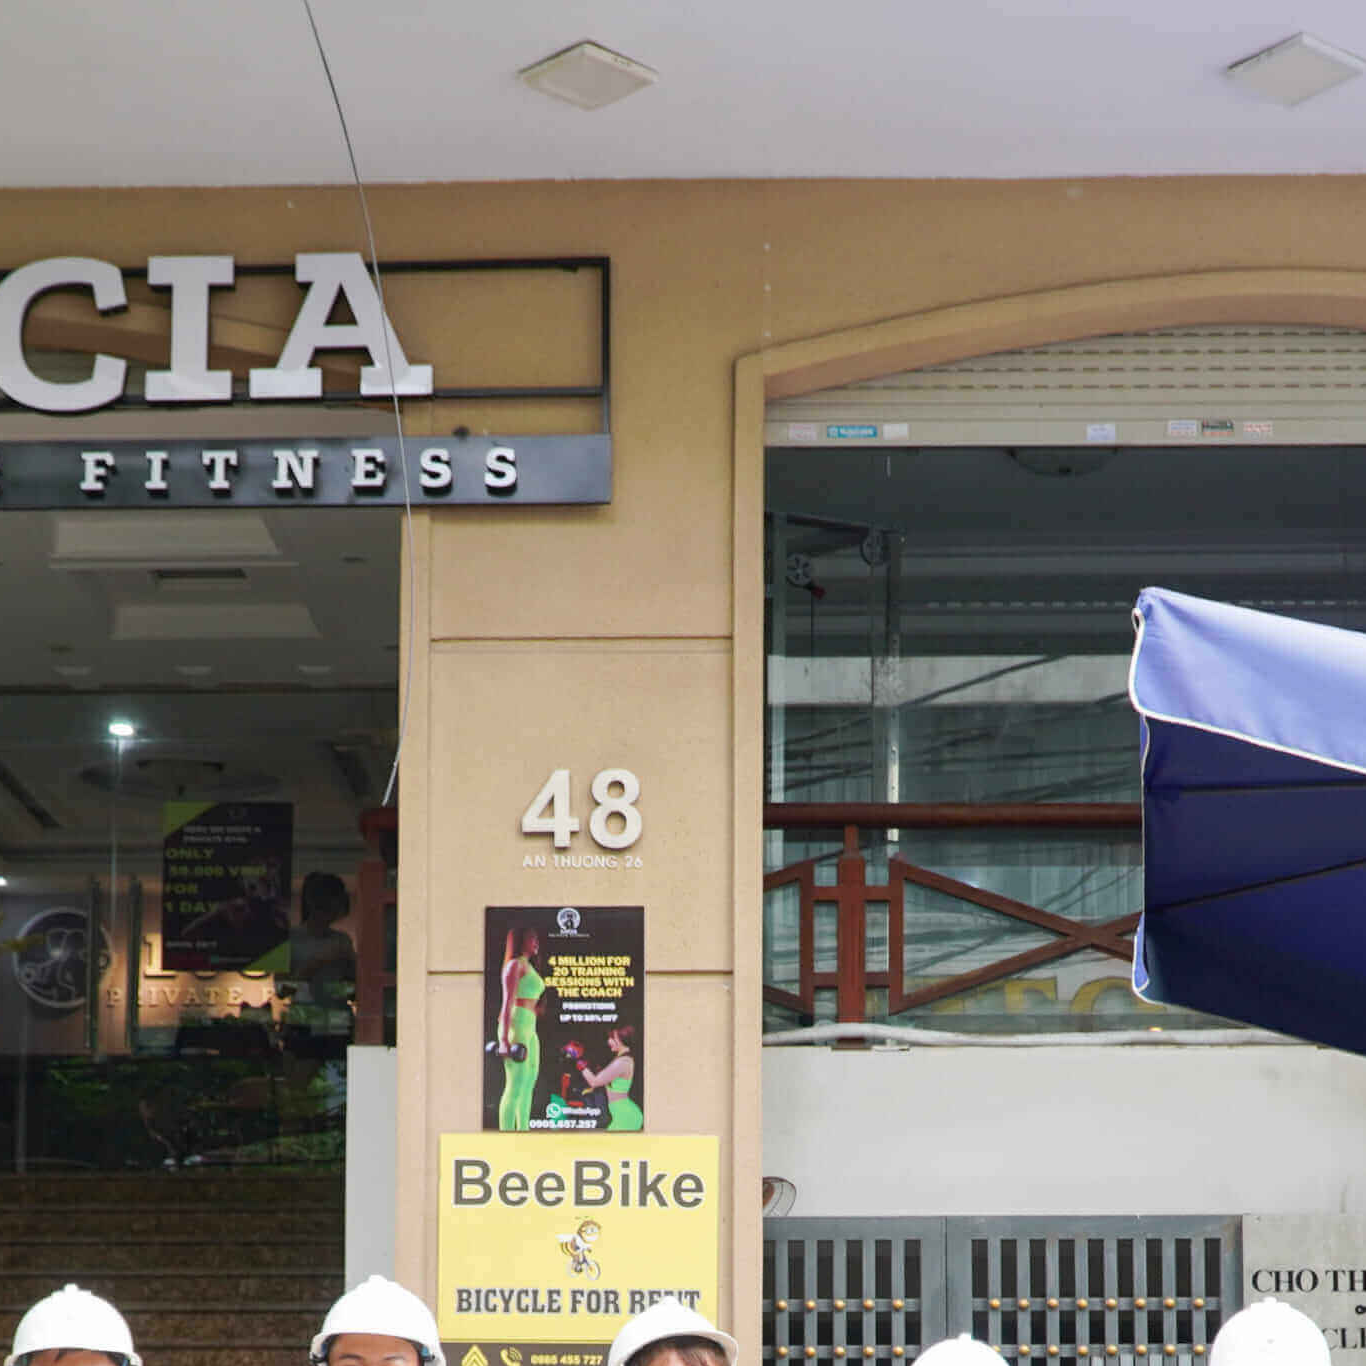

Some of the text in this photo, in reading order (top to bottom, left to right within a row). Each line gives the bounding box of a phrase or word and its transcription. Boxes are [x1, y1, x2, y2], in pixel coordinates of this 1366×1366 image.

[80, 446, 518, 492] FITNESS
[521, 767, 643, 850] 48
[522, 856, 546, 868] AN
[625, 856, 644, 868] 26
[558, 956, 605, 966] MILLION
[607, 956, 631, 966] FOR
[553, 967, 626, 977] 20 TRAINING
[545, 977, 634, 987] SESSIONS WITH
[557, 987, 622, 997] THE COACH
[453, 1158, 705, 1208] BeeBike
[1251, 1268, 1318, 1293] CHO
[455, 1288, 562, 1314] BICYCLE
[570, 1289, 621, 1314] FOR
